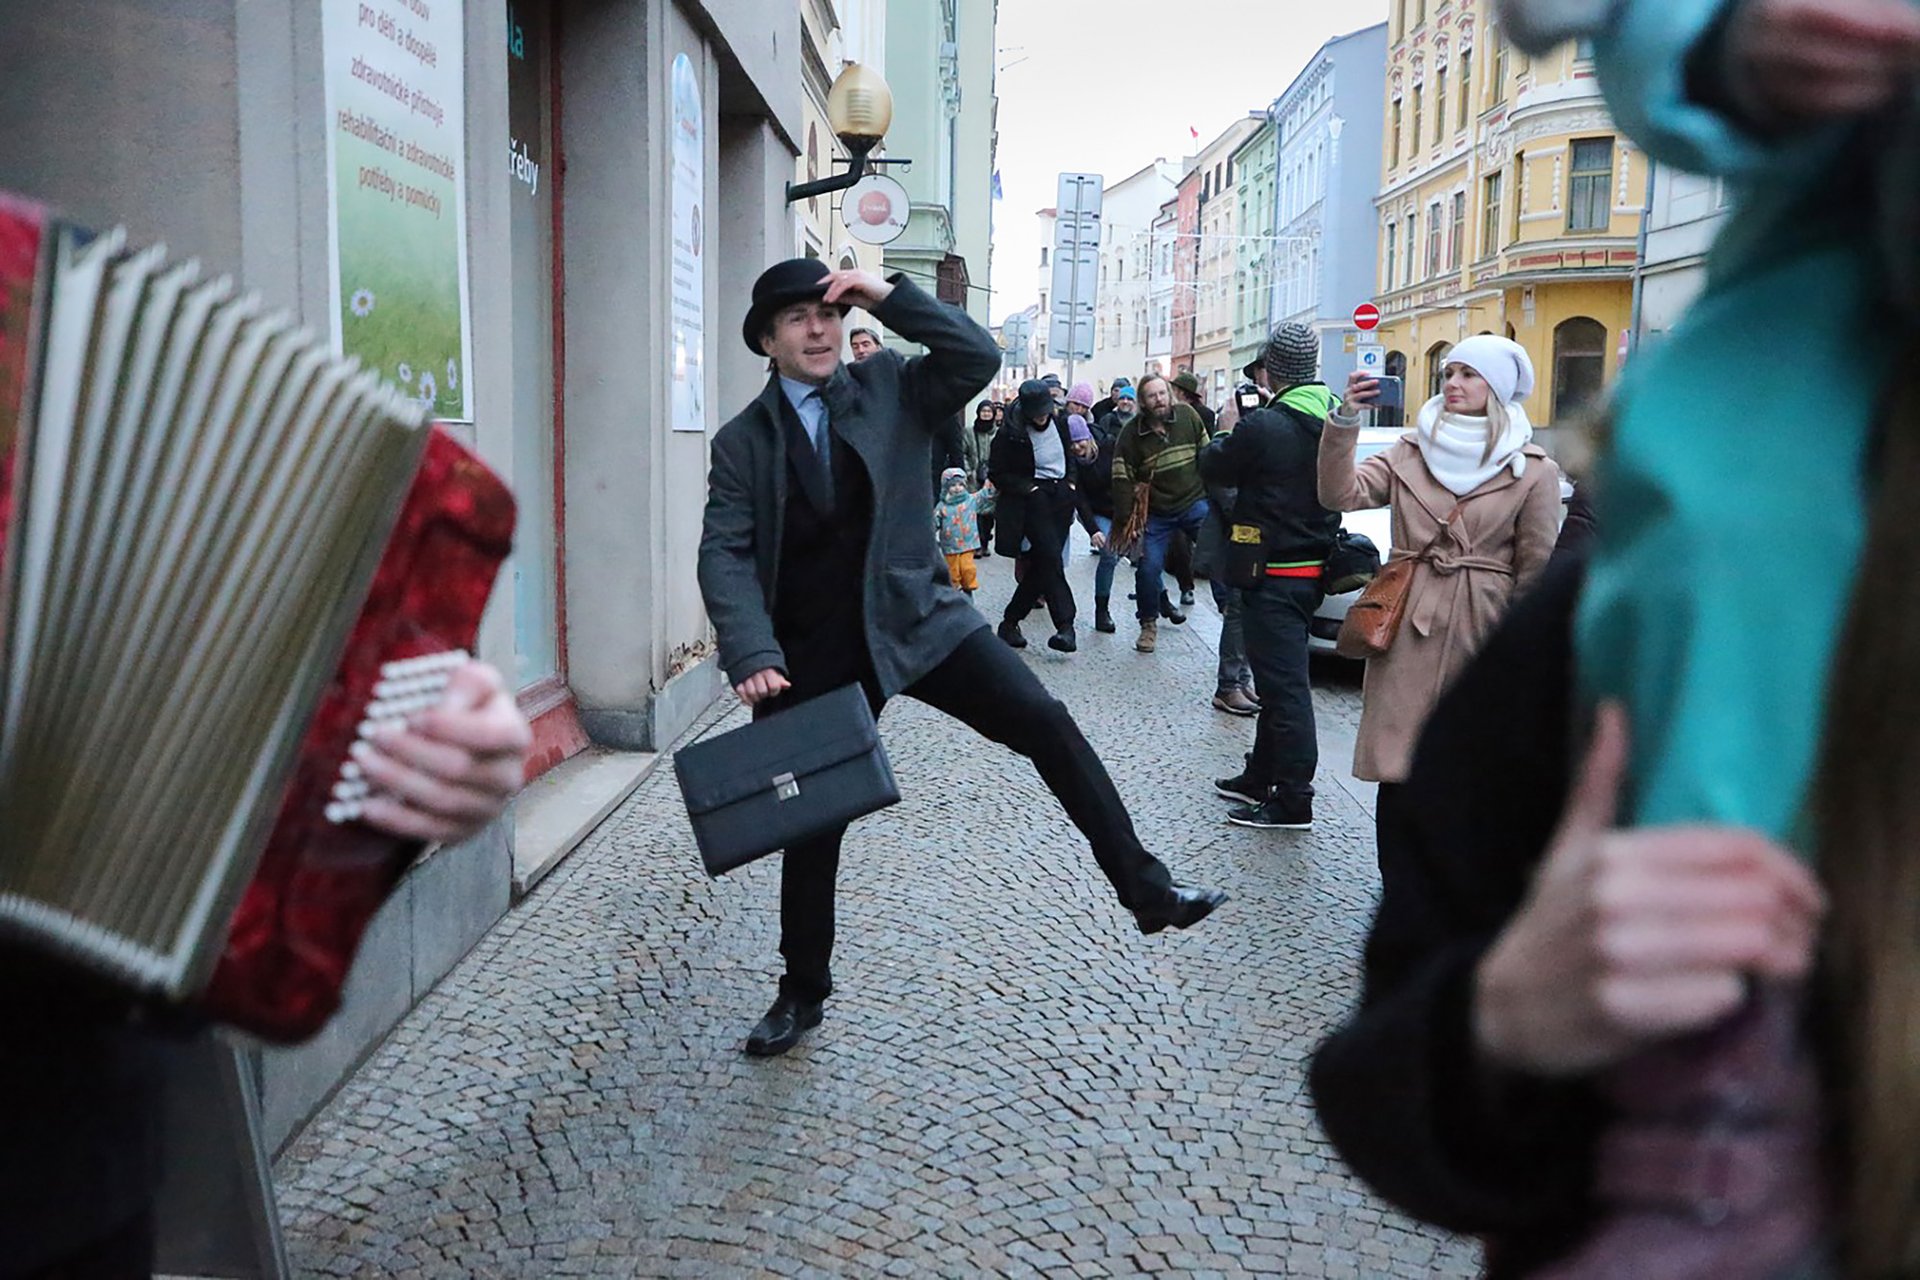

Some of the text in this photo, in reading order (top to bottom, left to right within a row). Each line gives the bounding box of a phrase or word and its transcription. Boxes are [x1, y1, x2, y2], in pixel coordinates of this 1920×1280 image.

[359, 3, 376, 28] pro
[378, 9, 396, 41] děti
[397, 28, 404, 46] a
[398, 139, 405, 157] a
[508, 137, 539, 196] řeby
[359, 166, 396, 203] potřeby
[397, 182, 404, 199] a
